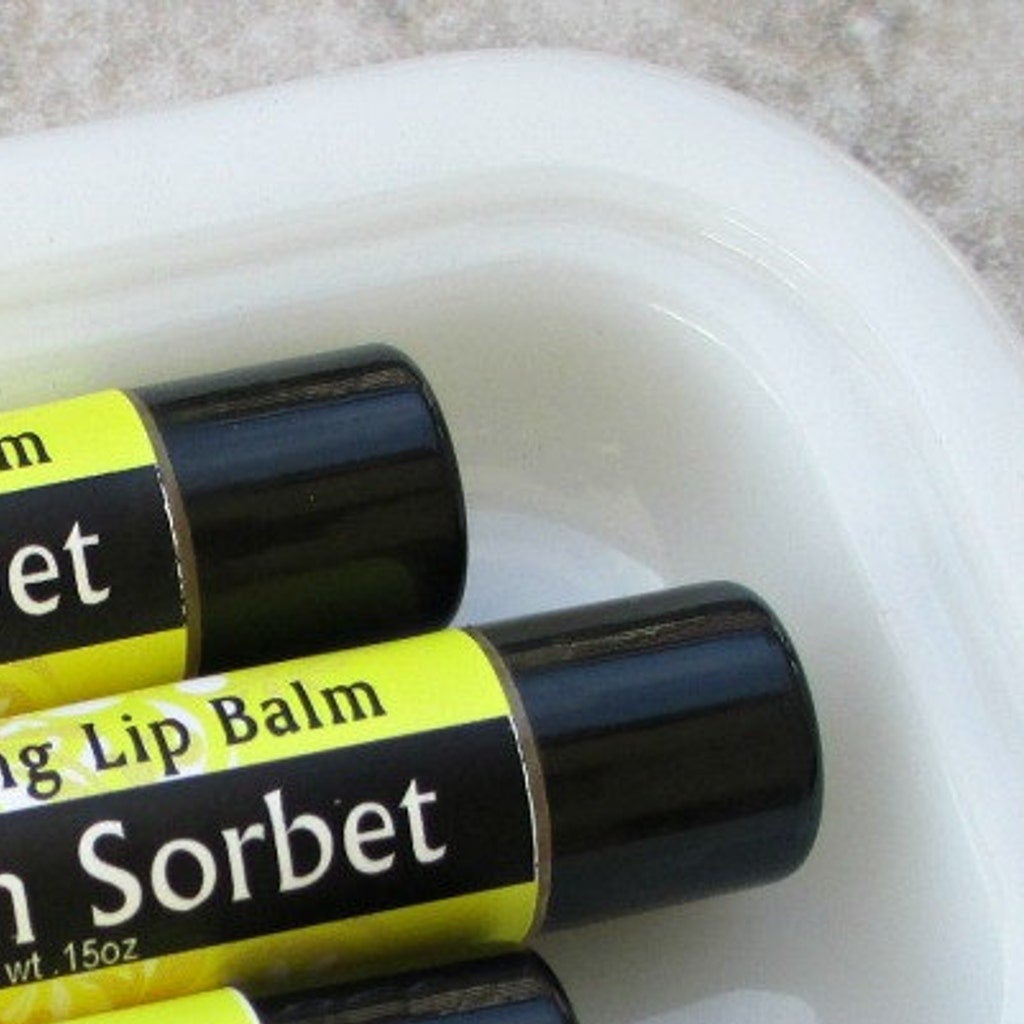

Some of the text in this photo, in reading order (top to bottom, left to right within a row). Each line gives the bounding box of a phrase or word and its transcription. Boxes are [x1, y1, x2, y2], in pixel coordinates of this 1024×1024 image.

[82, 714, 191, 776] Lip
[209, 674, 386, 742] Balm
[77, 778, 448, 925] Sorbet
[3, 956, 45, 988] wt
[53, 935, 139, 977] .15oz
